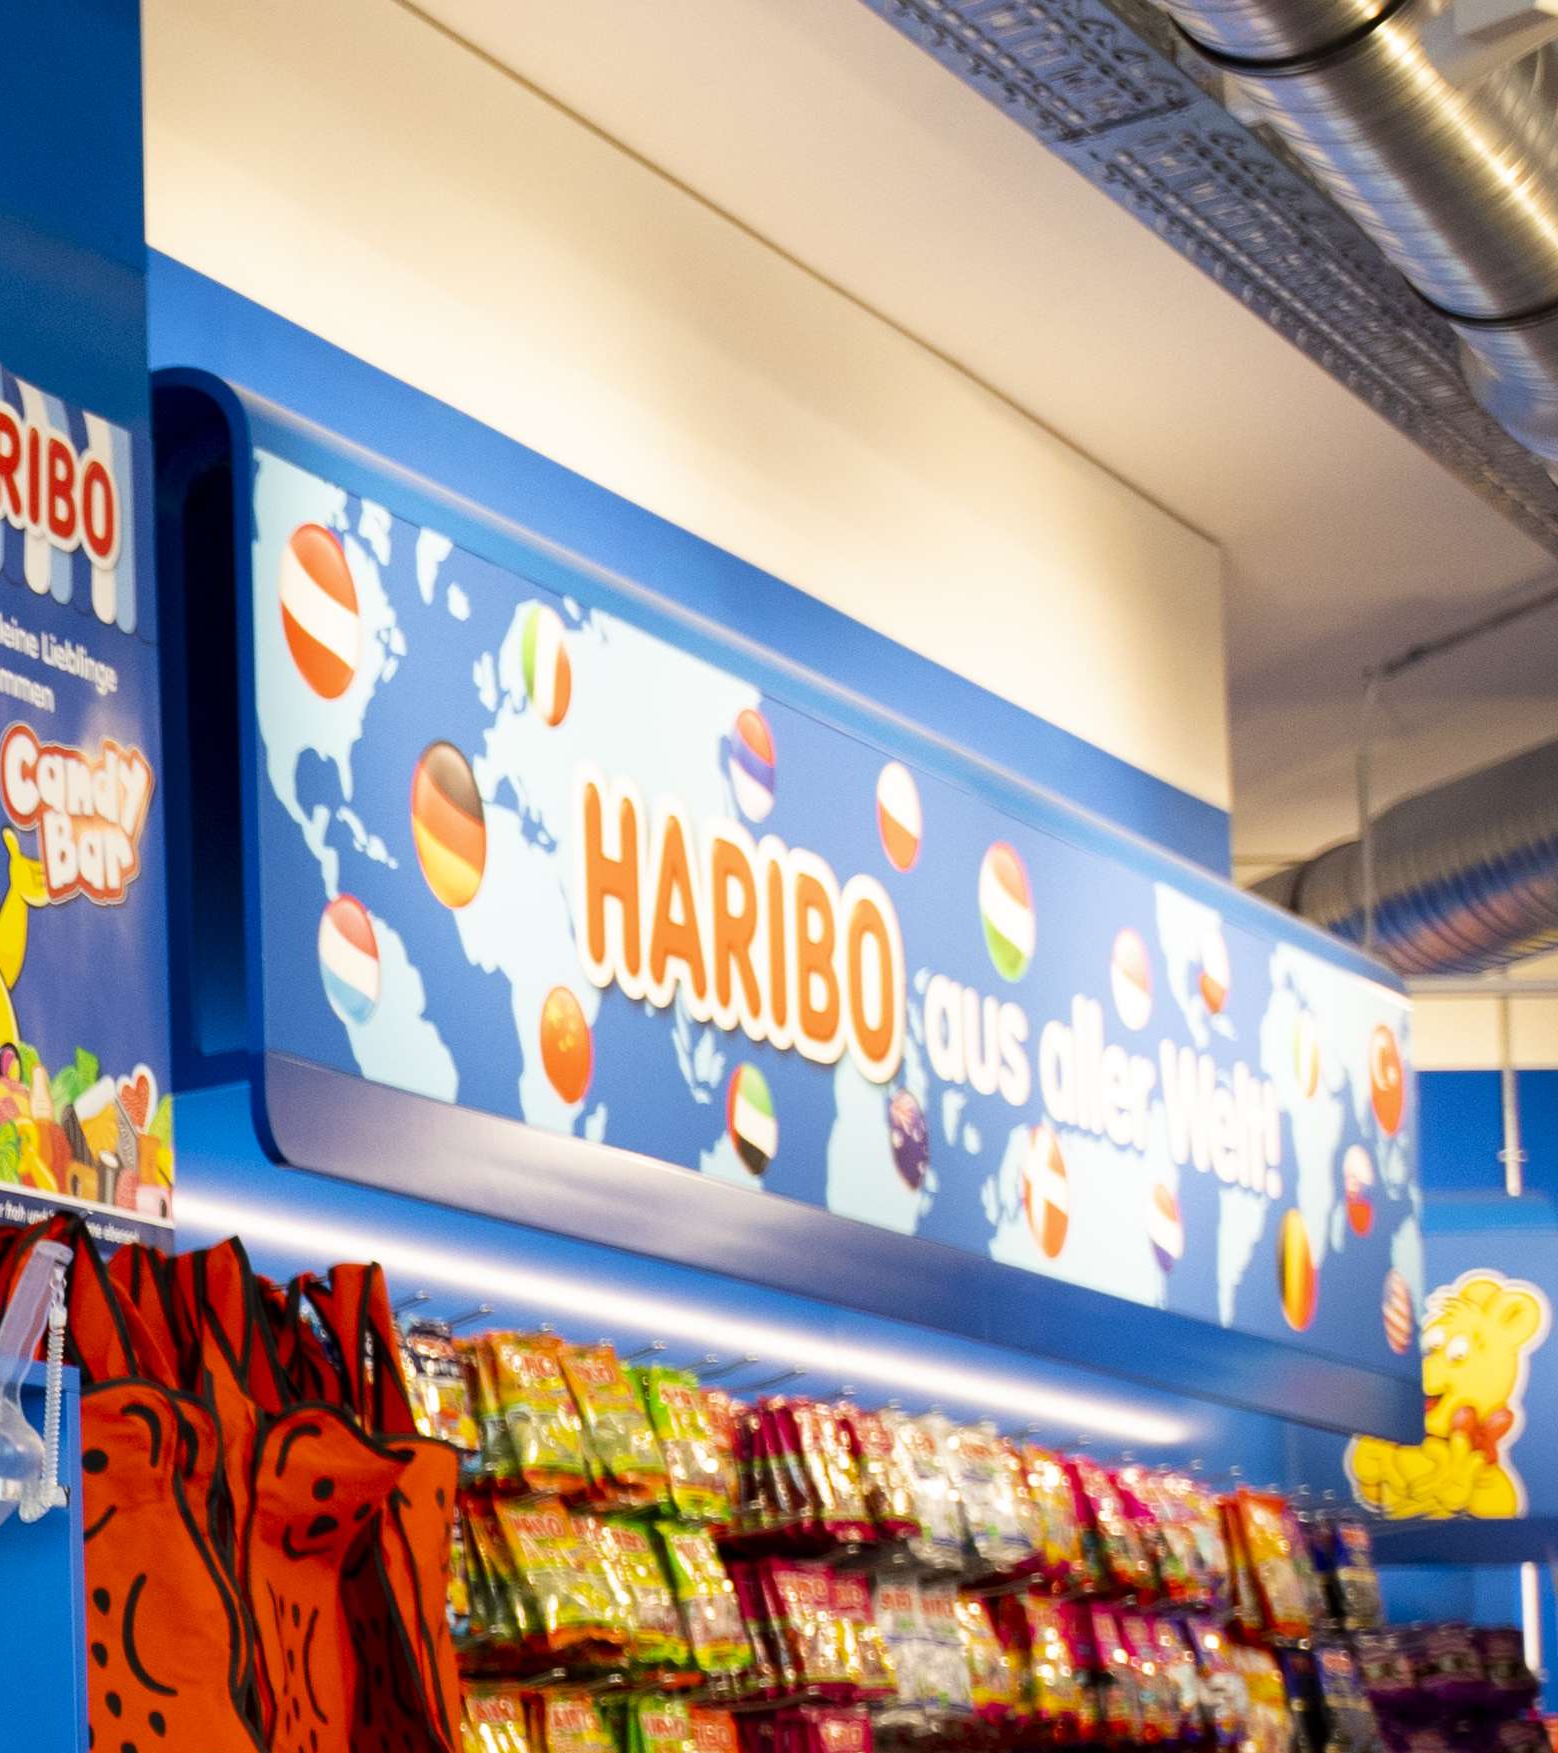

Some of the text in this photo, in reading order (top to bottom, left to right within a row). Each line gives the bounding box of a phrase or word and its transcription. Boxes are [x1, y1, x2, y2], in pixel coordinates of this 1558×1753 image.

[41, 632, 119, 697] Lieblinge
[5, 734, 147, 835] Candy
[44, 813, 136, 892] Bar
[583, 779, 1283, 1200] HARIBO aus aller Welt!
